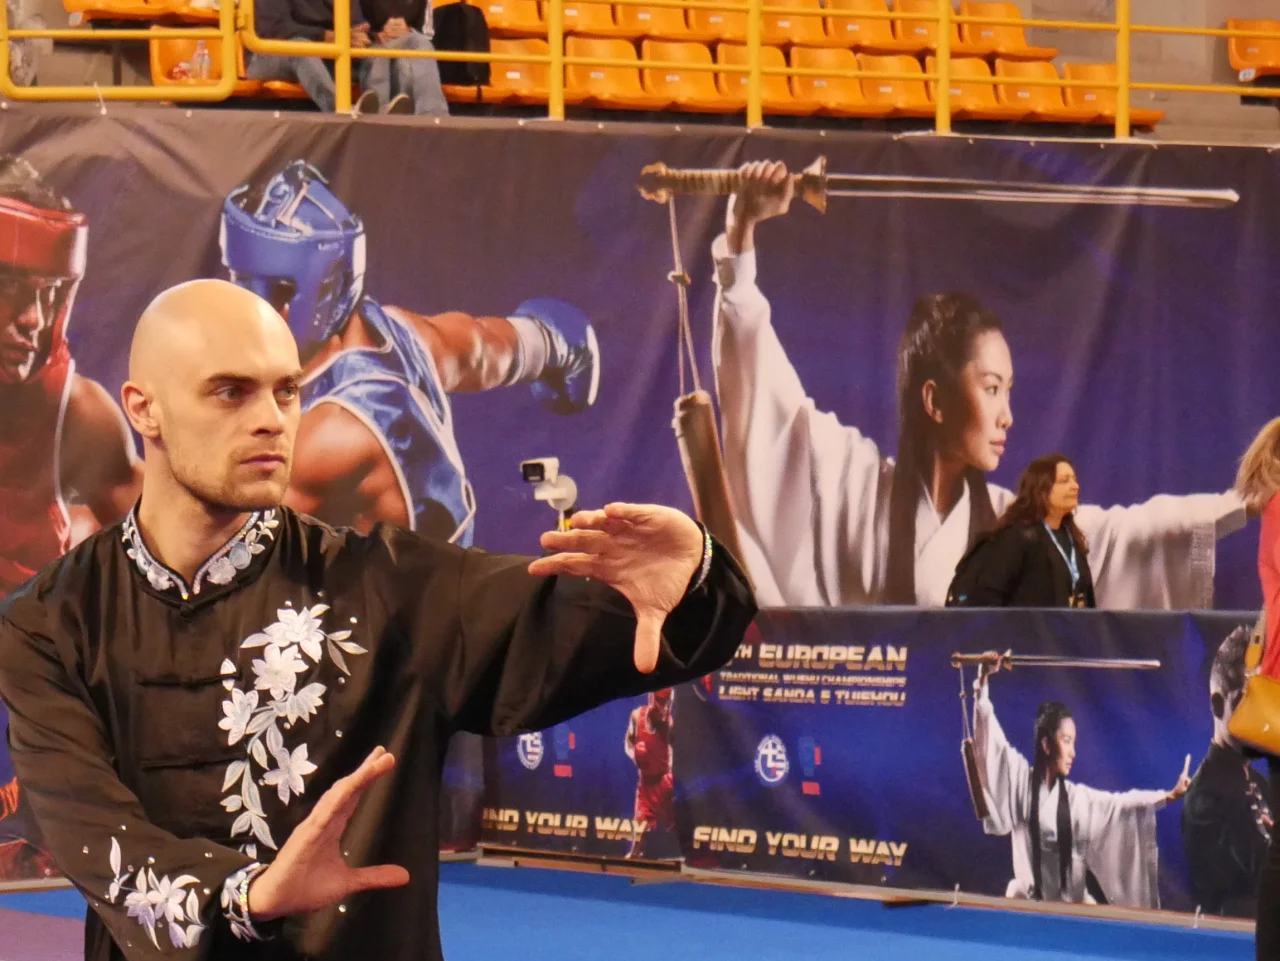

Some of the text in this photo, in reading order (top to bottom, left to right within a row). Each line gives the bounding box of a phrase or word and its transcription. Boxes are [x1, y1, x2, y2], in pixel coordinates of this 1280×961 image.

[758, 643, 907, 671] EUROPEAN
[525, 811, 588, 838] YOUR
[595, 816, 648, 842] WAY
[692, 826, 908, 867] FIND YOUR WAY
